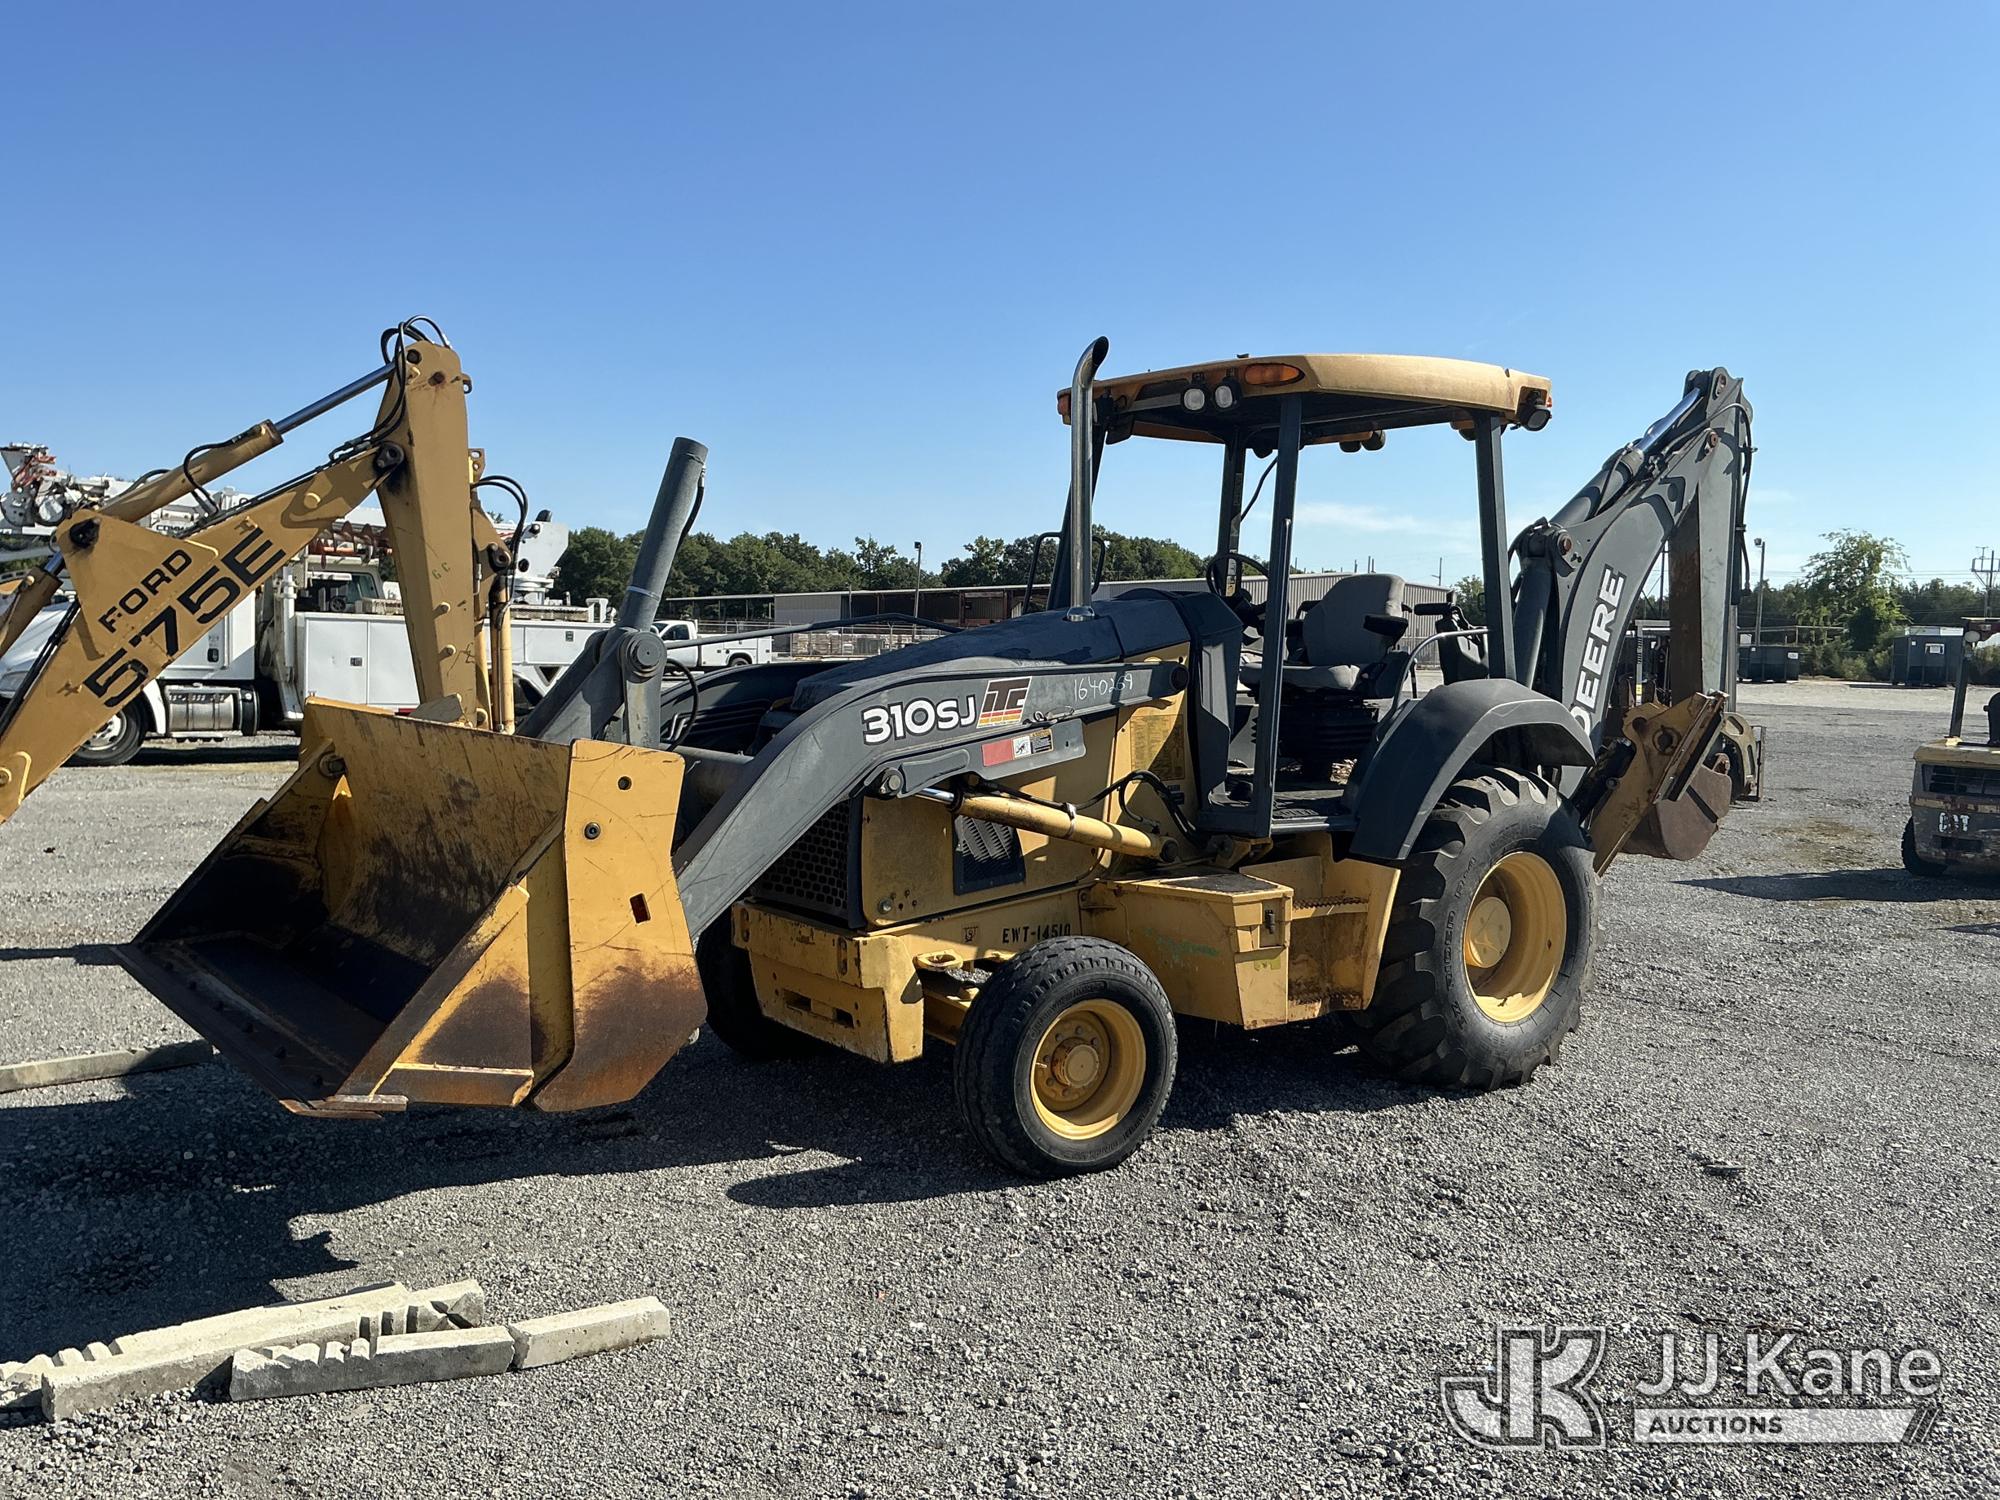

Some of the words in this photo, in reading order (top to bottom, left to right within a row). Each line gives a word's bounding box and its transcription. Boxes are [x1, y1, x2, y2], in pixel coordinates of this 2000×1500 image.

[98, 549, 192, 633] FORD
[83, 527, 286, 708] 575E
[1074, 673, 1133, 701] 1640269
[861, 694, 976, 745] 310SJ
[1002, 923, 1071, 944] EWT-14510
